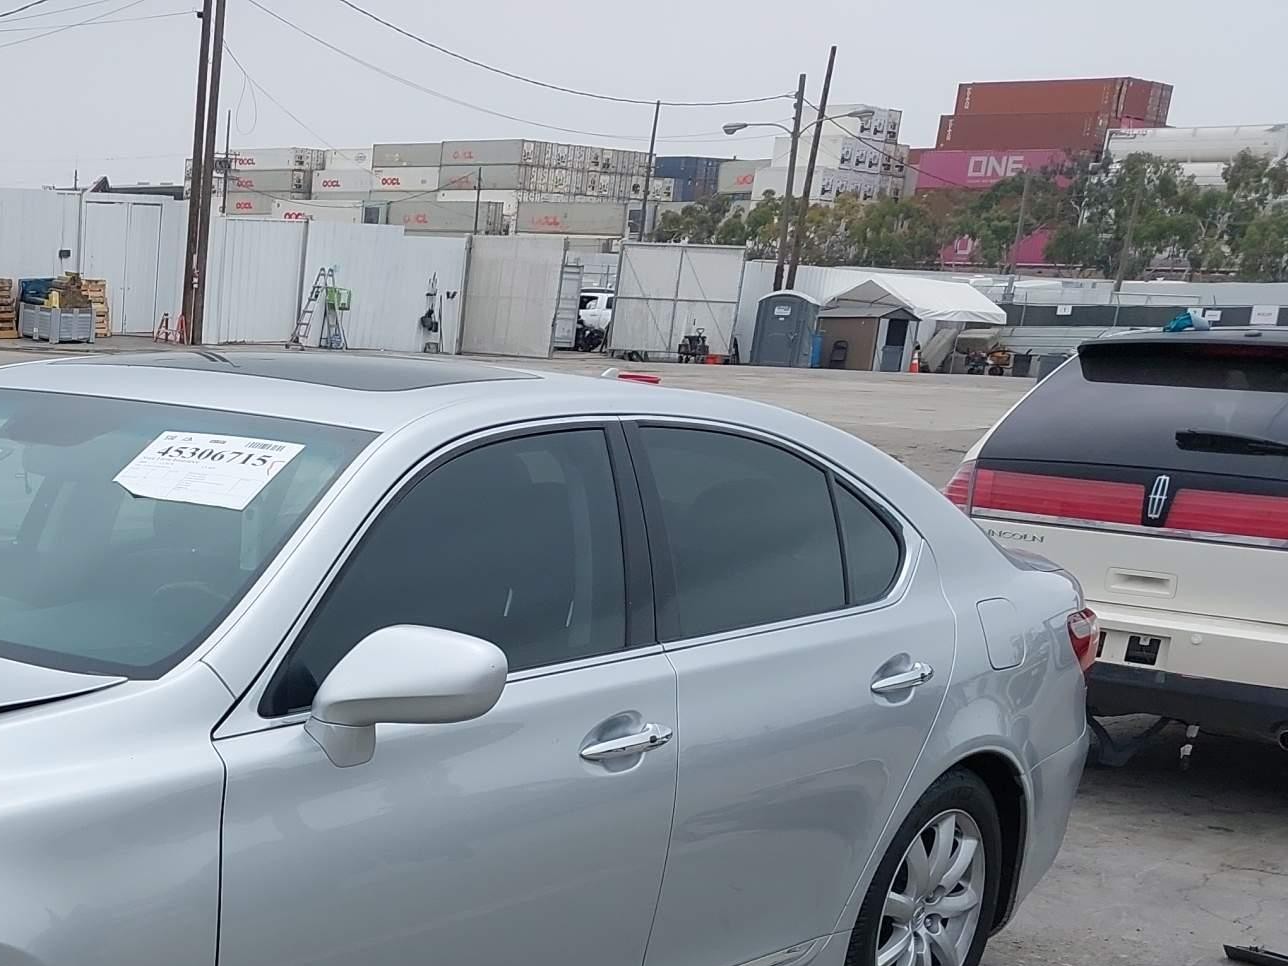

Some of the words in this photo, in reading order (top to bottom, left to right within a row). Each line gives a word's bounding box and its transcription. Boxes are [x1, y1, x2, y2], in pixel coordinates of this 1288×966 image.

[967, 155, 1025, 177] ONE
[381, 177, 401, 186] OOCL
[235, 202, 253, 210] OOCL
[157, 445, 272, 466] 45306715
[985, 528, 1045, 543] INCOLN
